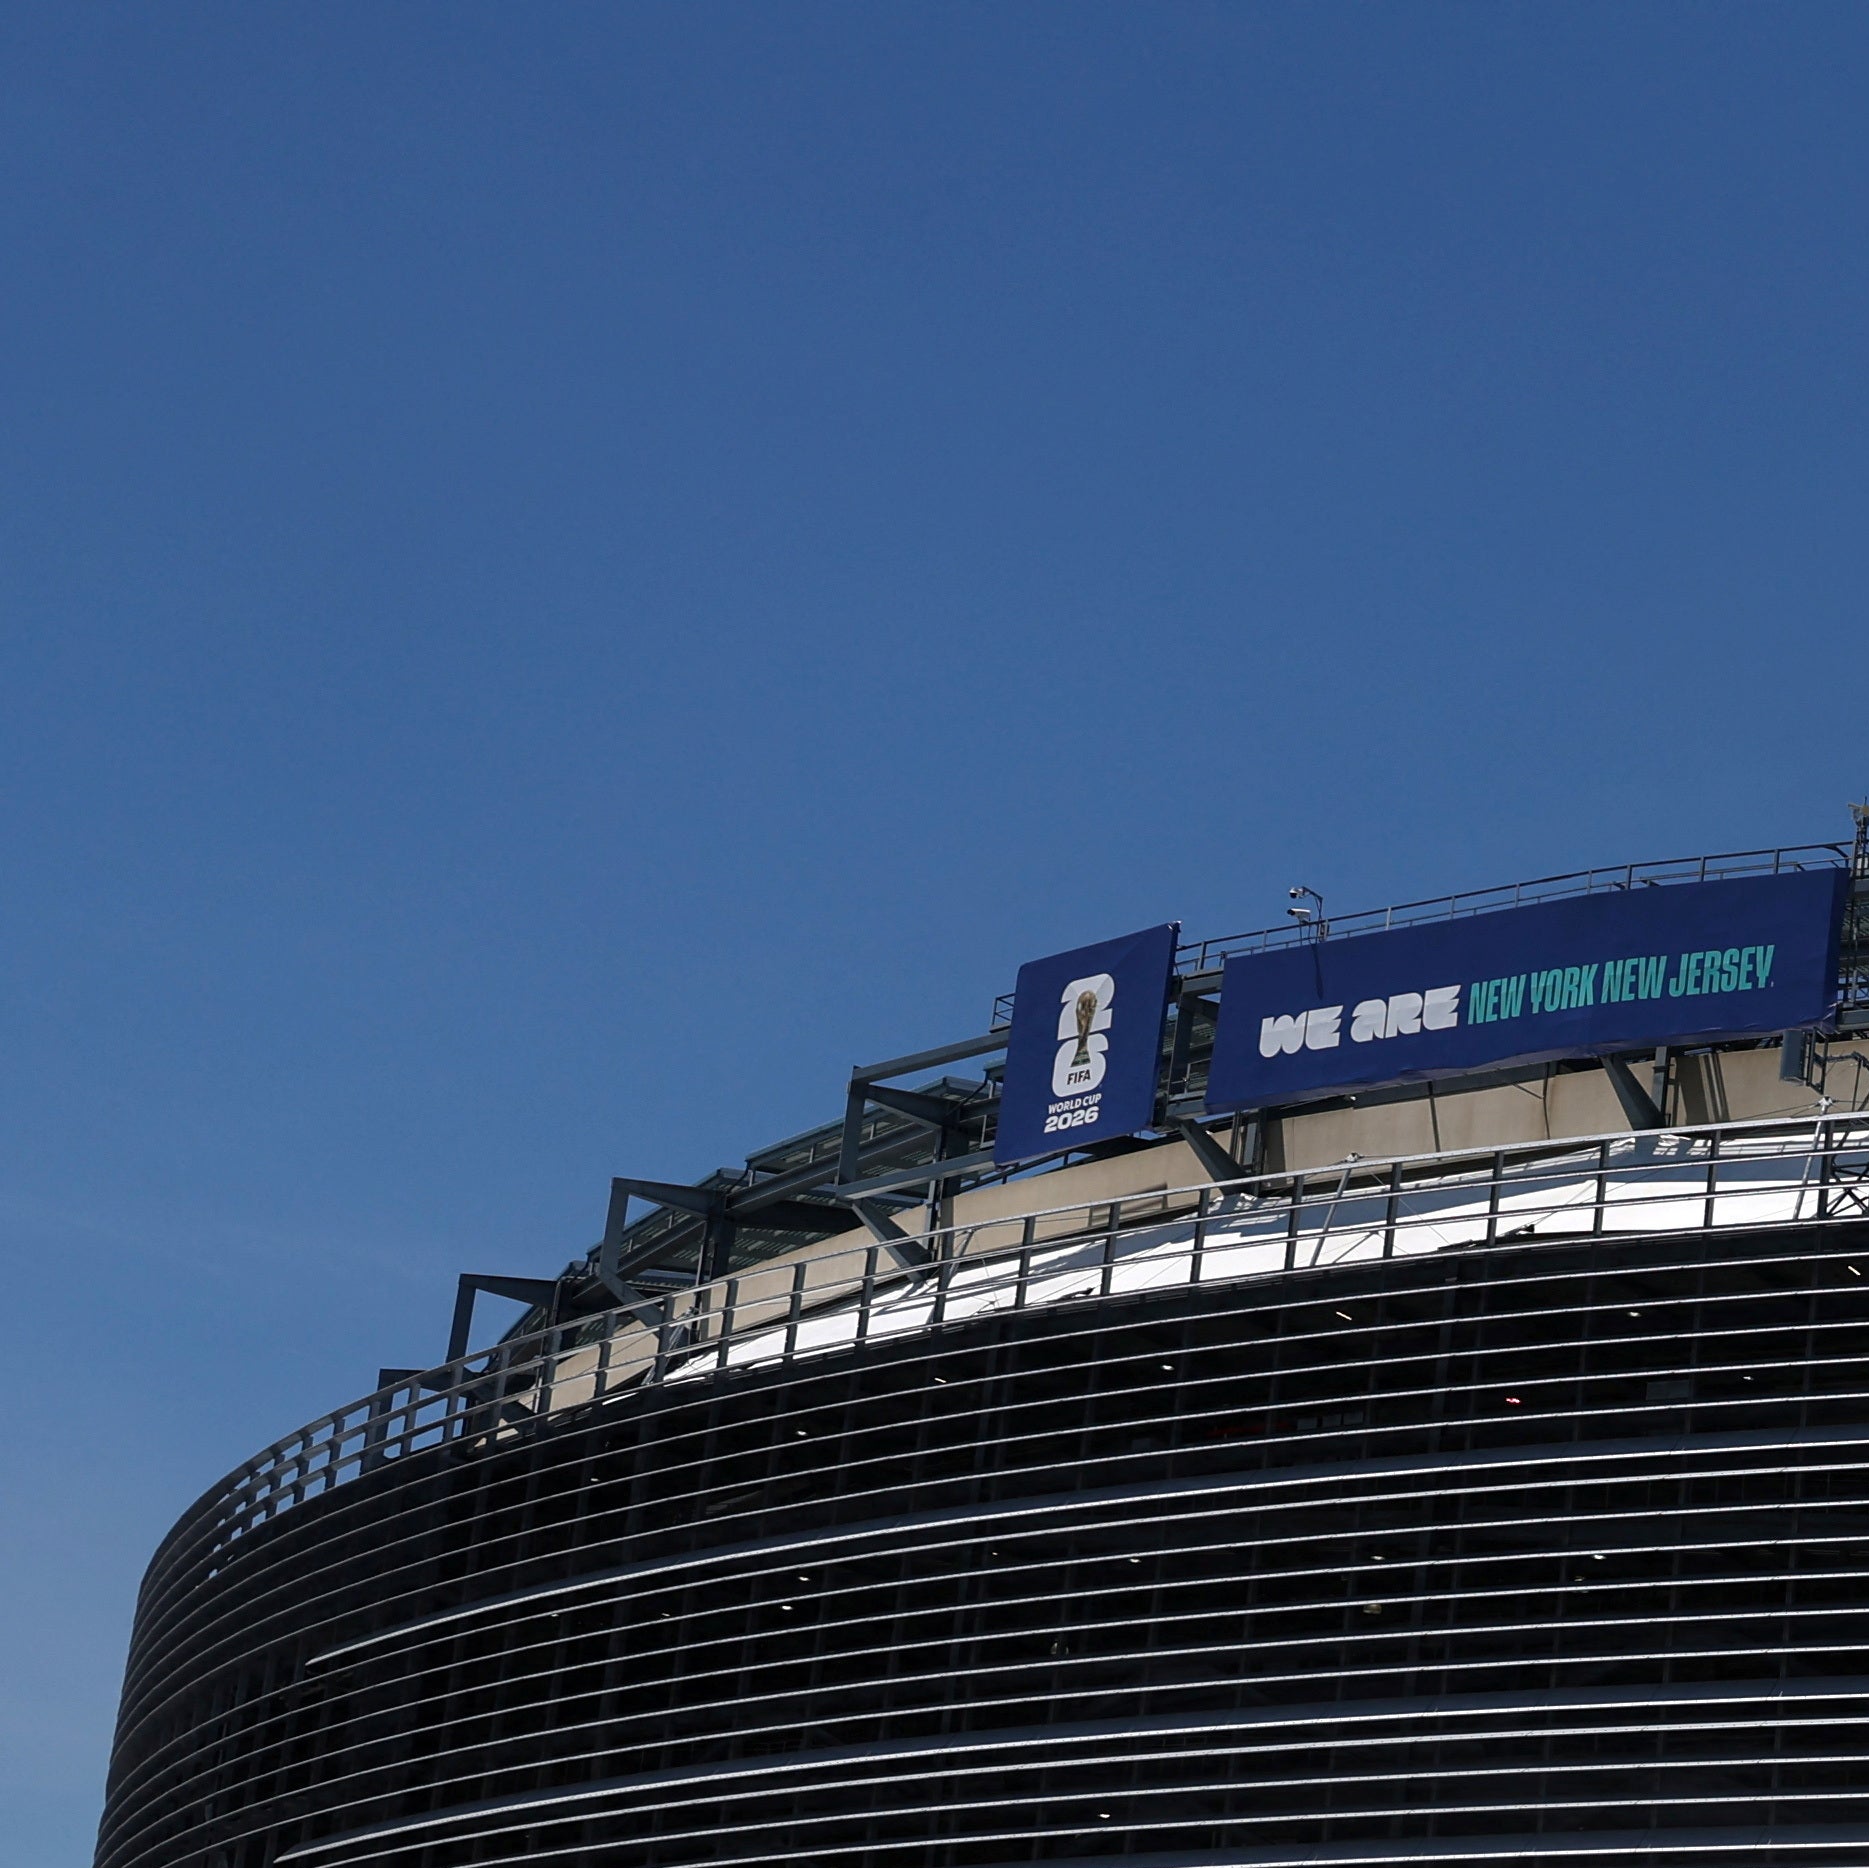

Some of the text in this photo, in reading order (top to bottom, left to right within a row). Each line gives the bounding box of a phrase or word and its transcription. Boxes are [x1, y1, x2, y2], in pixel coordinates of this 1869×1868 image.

[1259, 1005, 1343, 1058] WE
[1467, 975, 1527, 1025] NEW
[1529, 963, 1598, 1015] YORK
[1599, 955, 1667, 1004] NEW
[1668, 945, 1775, 998] JERSEY
[1067, 1069, 1091, 1085] FIFA
[1048, 1093, 1102, 1115] WORLD CUP
[1044, 1106, 1100, 1133] 2026
